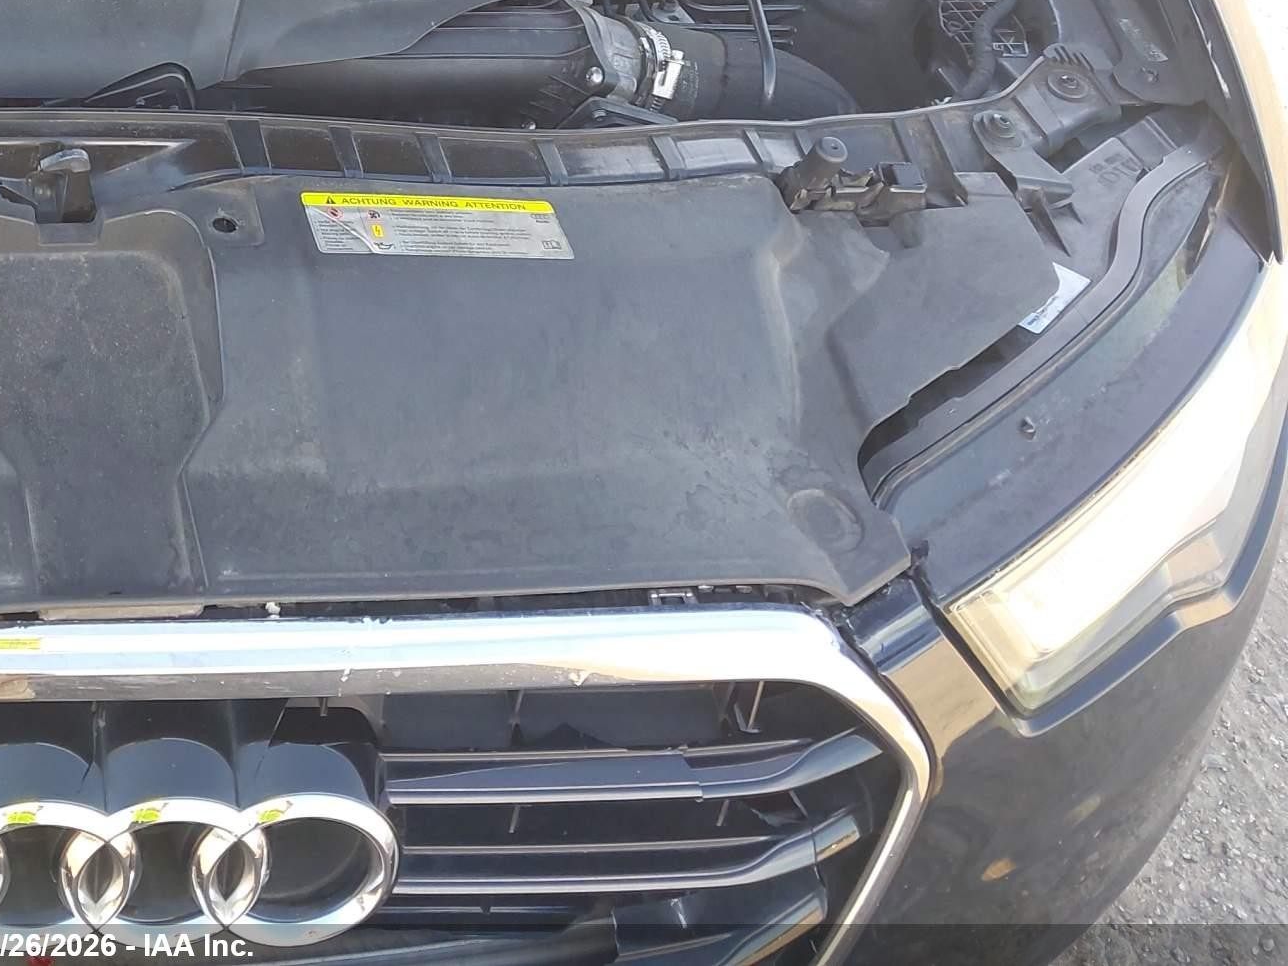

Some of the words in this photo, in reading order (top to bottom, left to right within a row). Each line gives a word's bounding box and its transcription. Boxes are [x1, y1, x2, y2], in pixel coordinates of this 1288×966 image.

[341, 197, 397, 206] ACHTUNG
[402, 199, 458, 208] WARNING
[464, 201, 527, 210] ATTENTION
